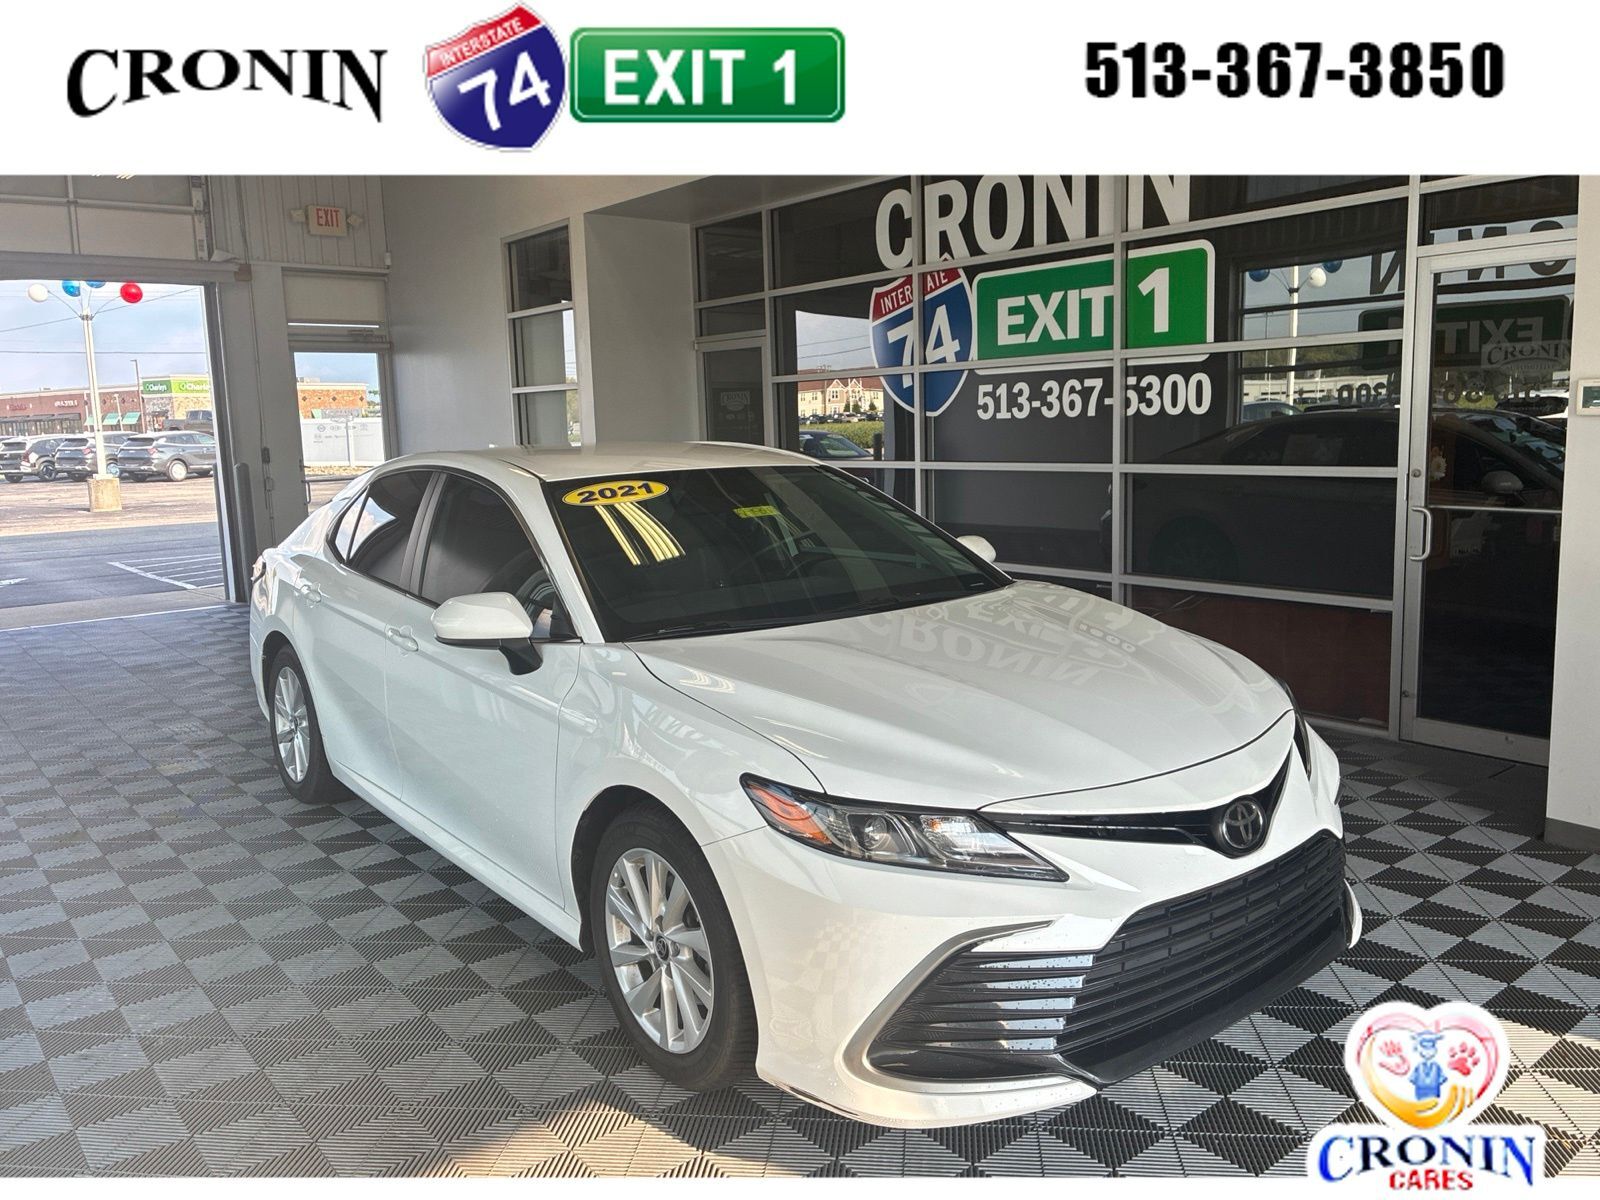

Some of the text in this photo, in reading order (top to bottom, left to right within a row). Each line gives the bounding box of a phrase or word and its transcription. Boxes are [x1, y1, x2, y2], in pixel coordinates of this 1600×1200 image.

[315, 207, 341, 228] EXIT
[875, 175, 1190, 271] CRONIN
[880, 270, 949, 315] INTERATE
[997, 266, 1170, 346] EXIT 1
[886, 304, 960, 388] 74
[976, 373, 1212, 420] 513-367-5300
[577, 482, 654, 503] 2021
